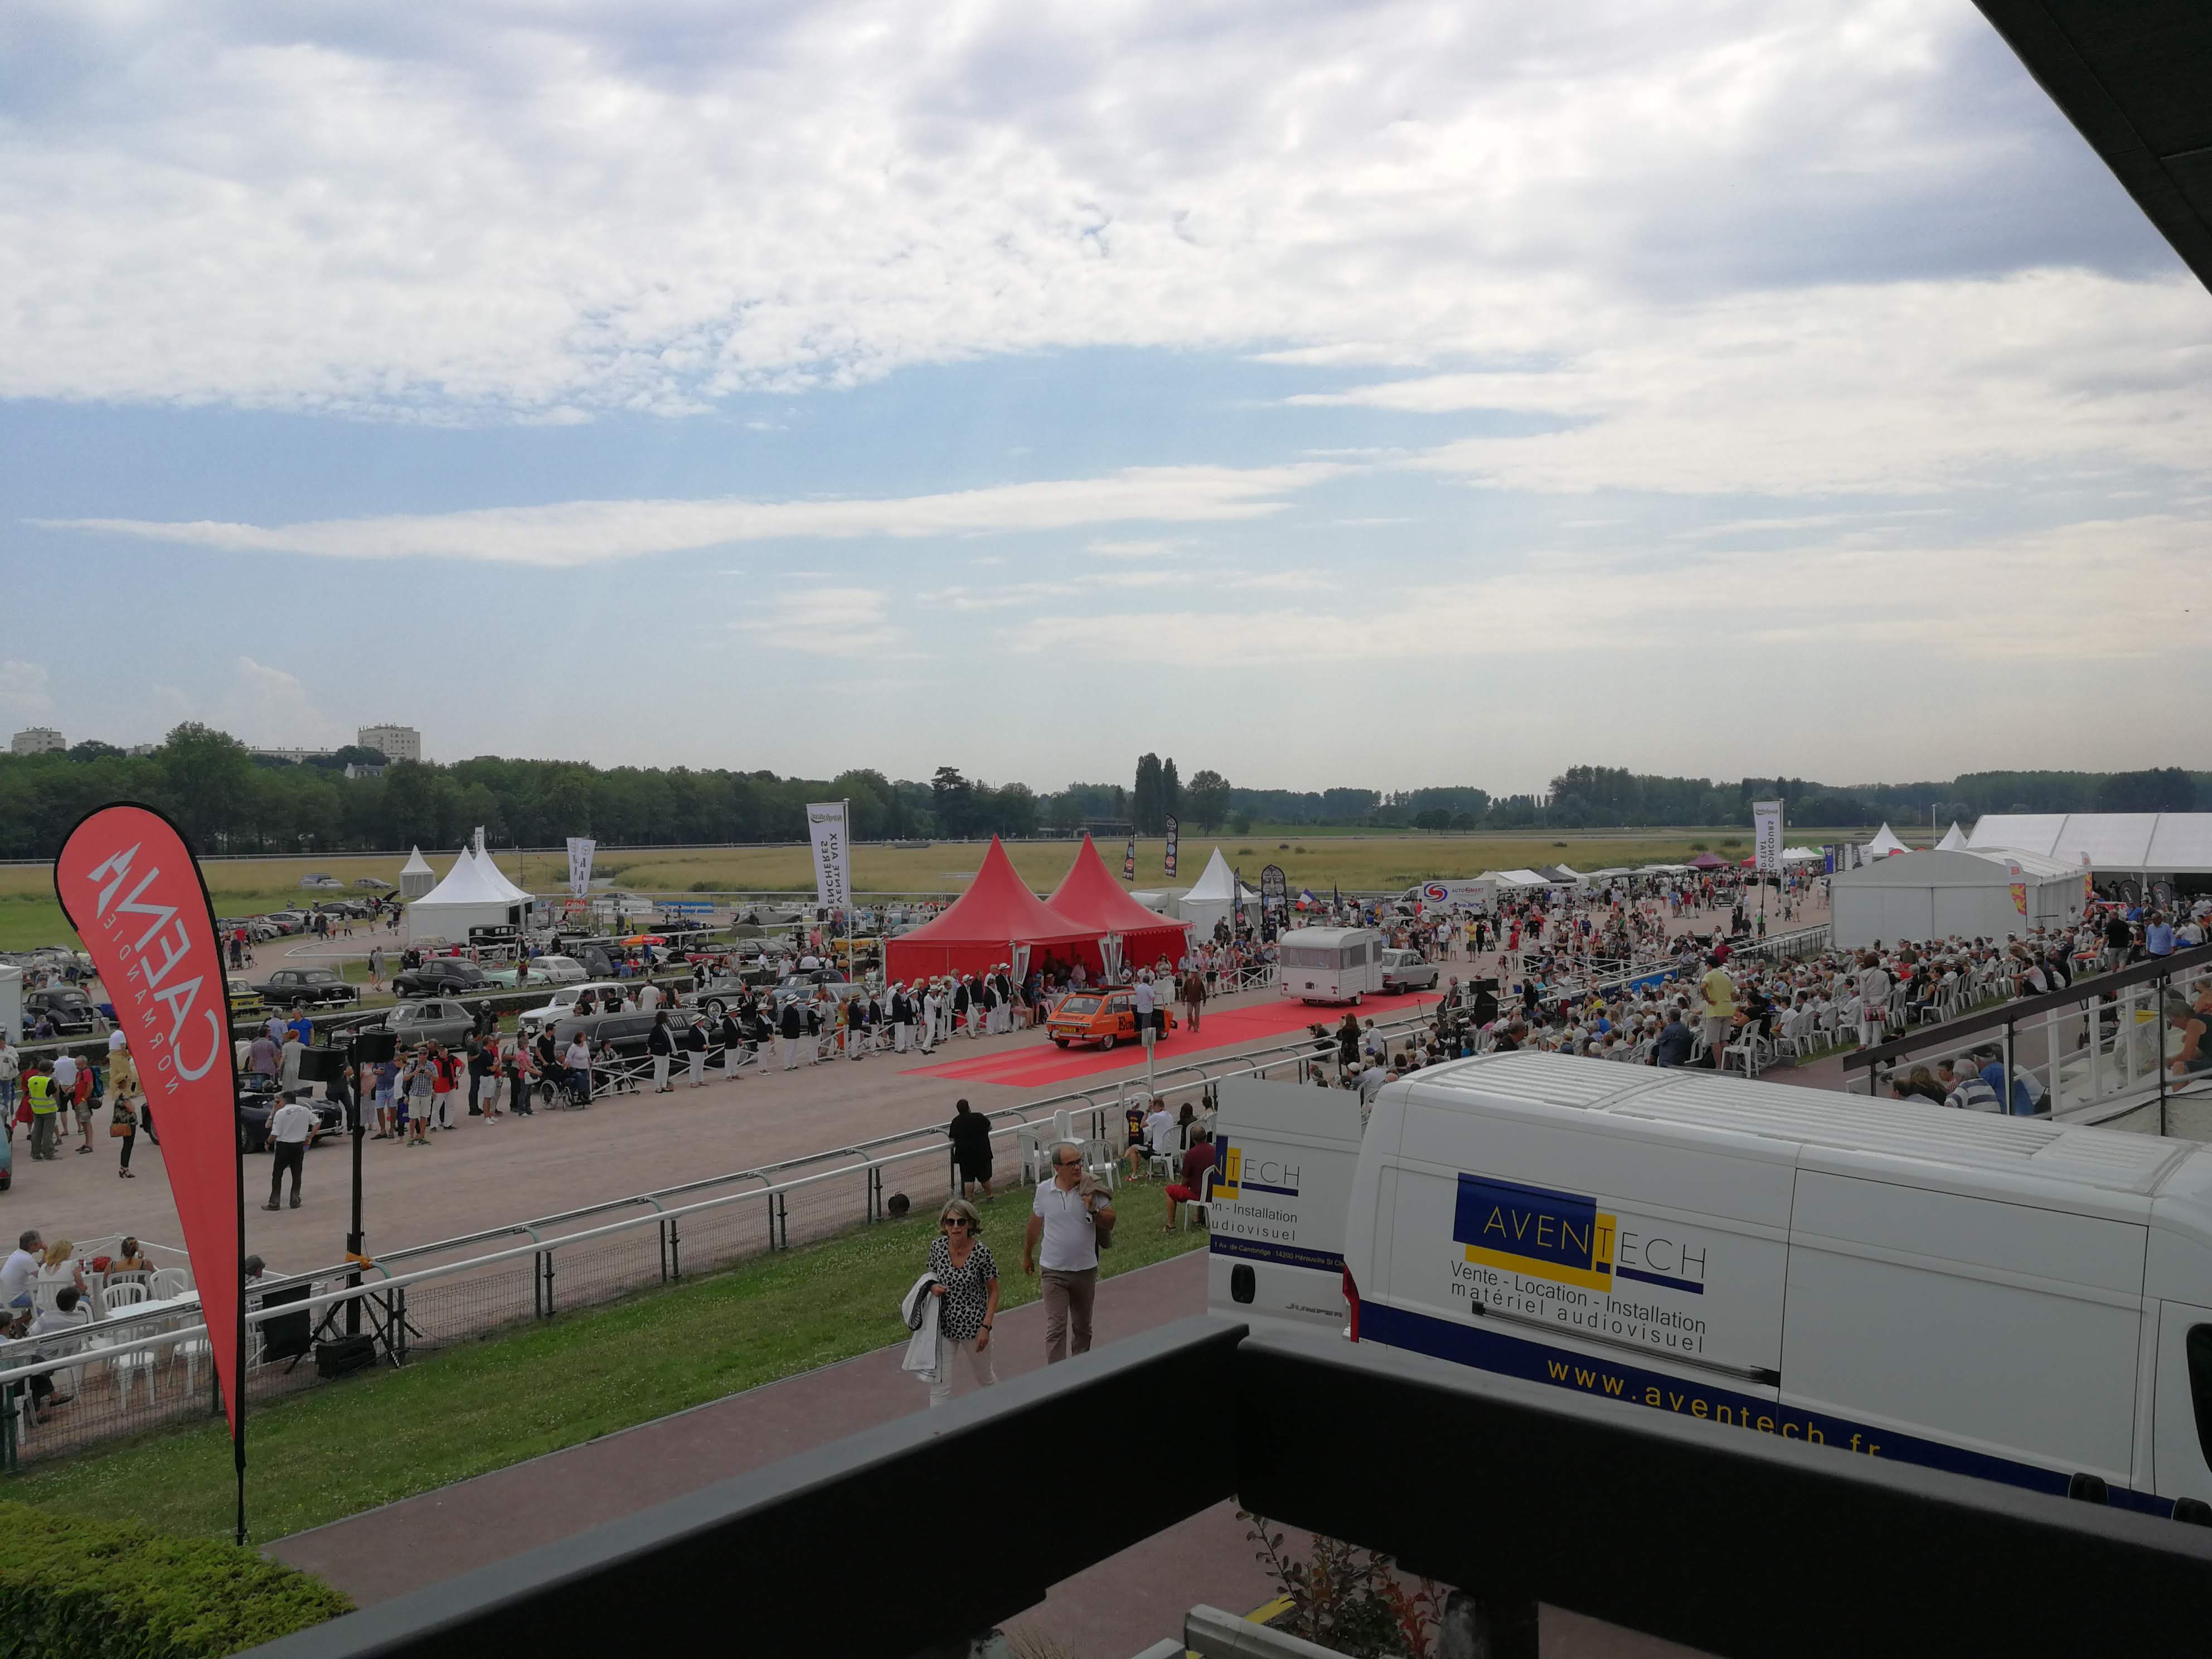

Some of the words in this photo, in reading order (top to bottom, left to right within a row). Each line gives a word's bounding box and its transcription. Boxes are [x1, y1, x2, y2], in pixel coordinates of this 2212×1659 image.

[1212, 1220, 1296, 1241] udiovisuel
[1234, 1202, 1298, 1224] Installation
[1483, 1205, 1706, 1279] AVENTECH
[1451, 1260, 1498, 1286] Vente
[1515, 1275, 1587, 1307] Location
[1606, 1296, 1706, 1335] Installation
[1452, 1281, 1544, 1316] matériel
[1558, 1307, 1702, 1353] audiovisuel
